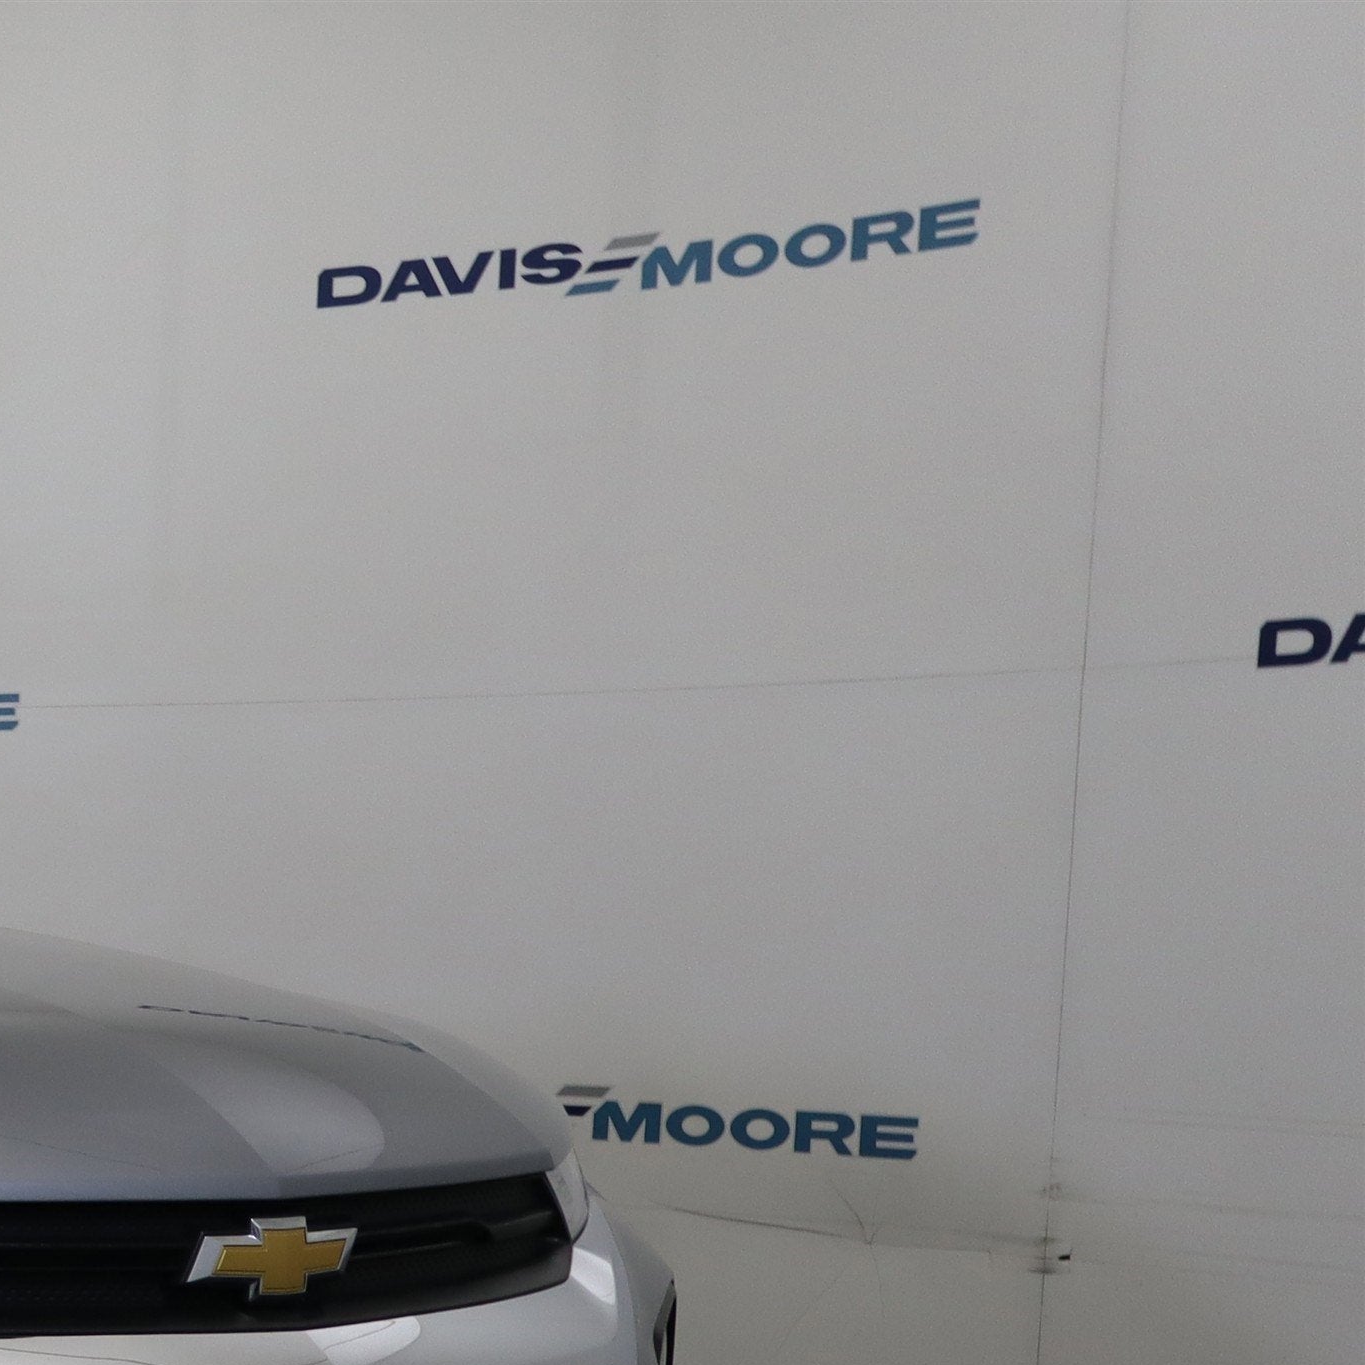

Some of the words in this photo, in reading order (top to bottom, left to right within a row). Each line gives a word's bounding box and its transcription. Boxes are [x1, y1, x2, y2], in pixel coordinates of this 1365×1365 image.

[316, 243, 582, 309] DAVIS
[640, 198, 981, 290] MOORE
[592, 1100, 919, 1160] MOORE
